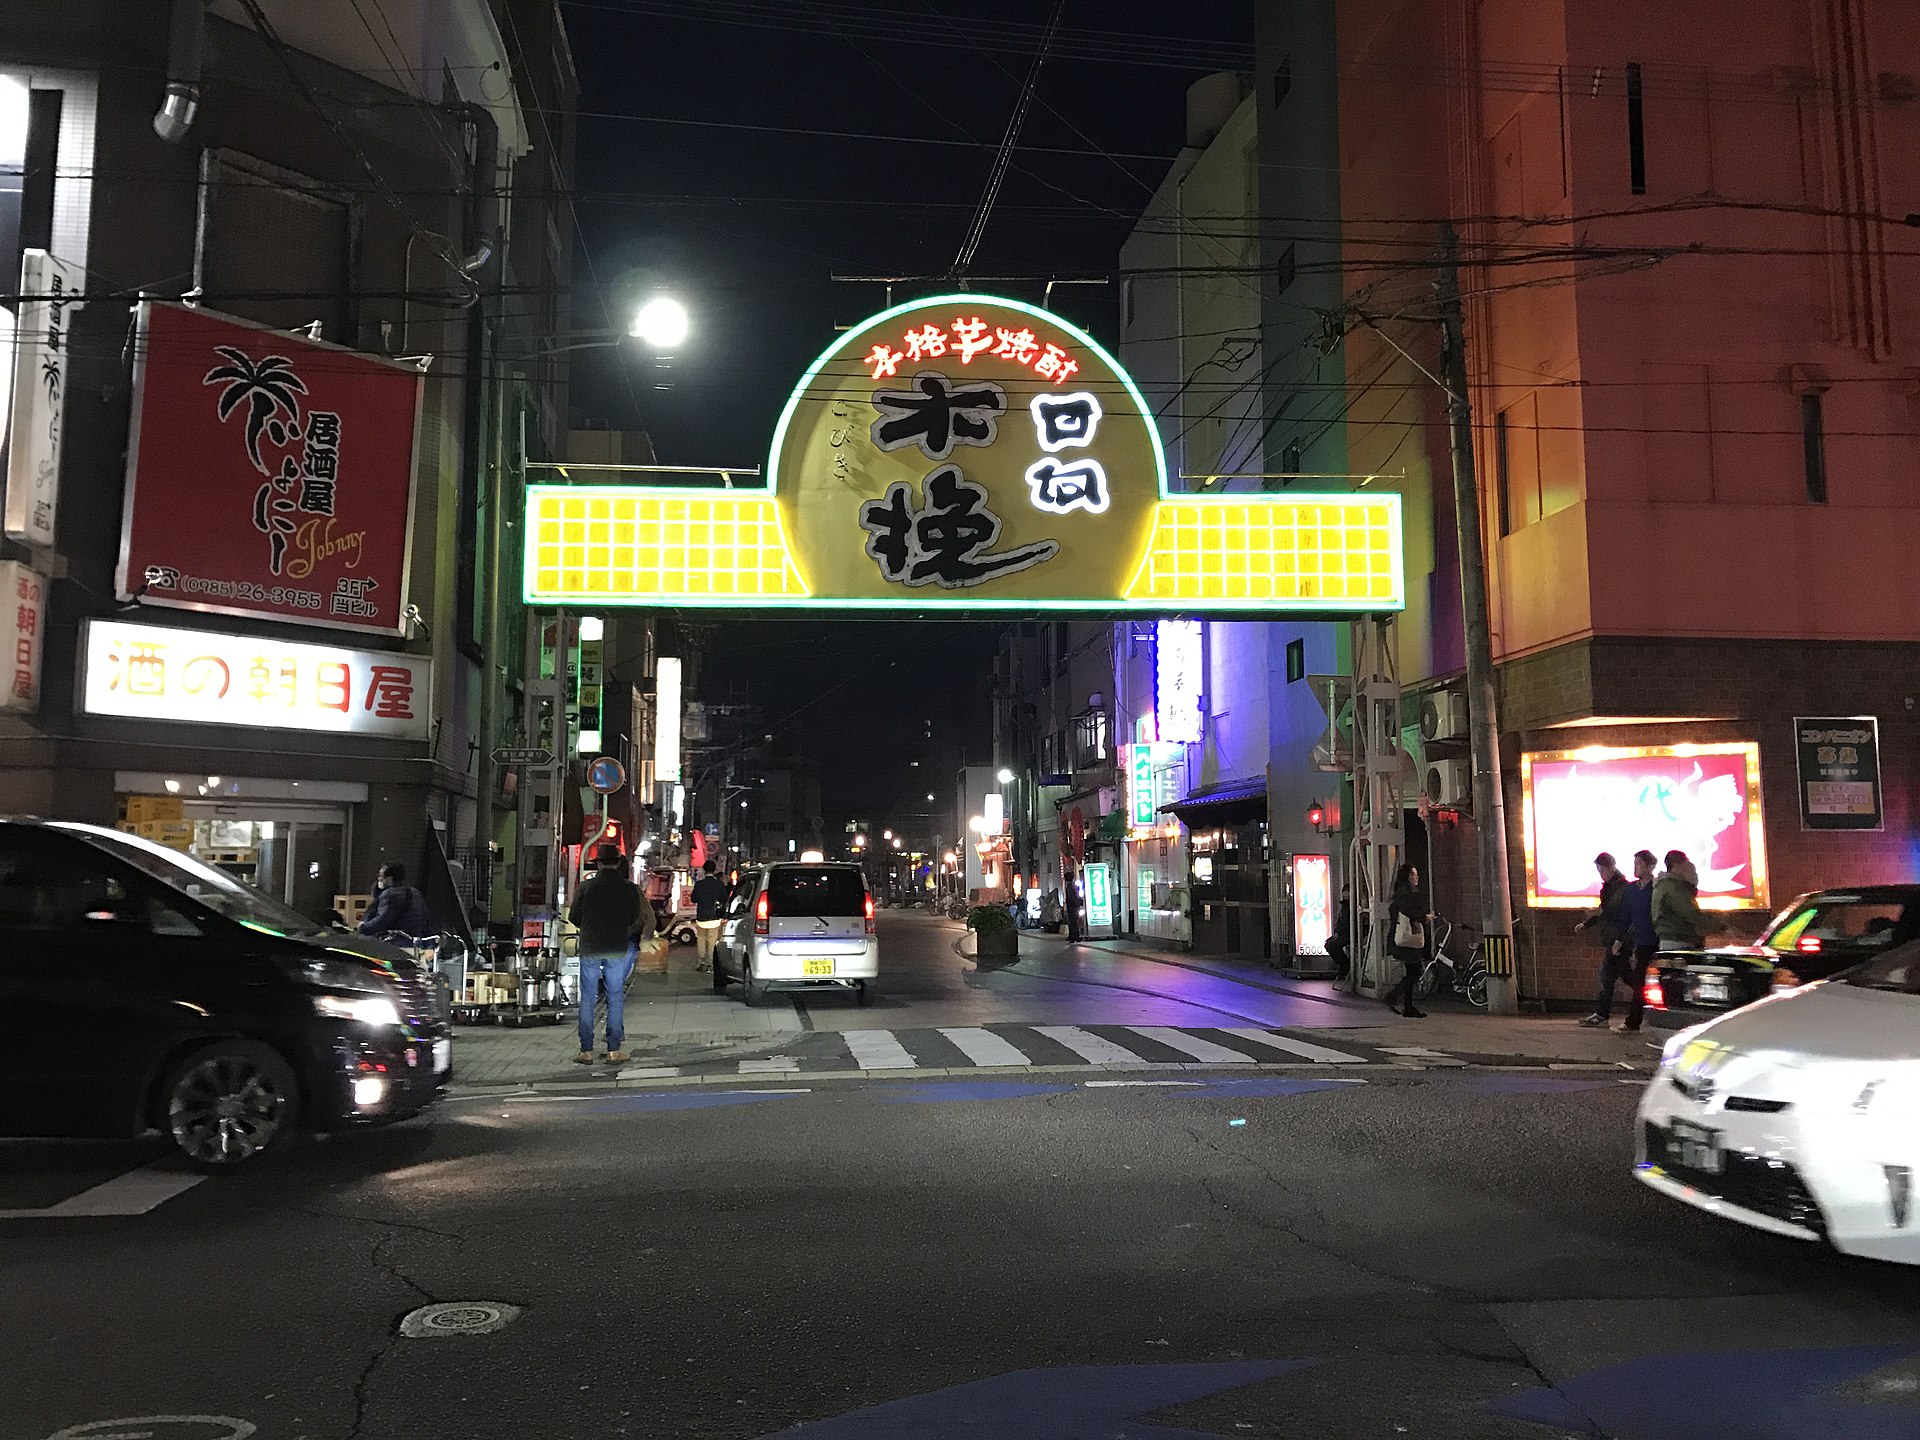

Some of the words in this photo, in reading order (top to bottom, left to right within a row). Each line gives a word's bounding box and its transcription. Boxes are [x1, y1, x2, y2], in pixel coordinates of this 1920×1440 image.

[864, 316, 1079, 385] 本格芋焼酎
[299, 410, 341, 516] 居酒屋
[1026, 391, 1110, 514] 日向
[180, 576, 322, 609] (0985)26-3955
[109, 639, 415, 720] 酒の朝日屋
